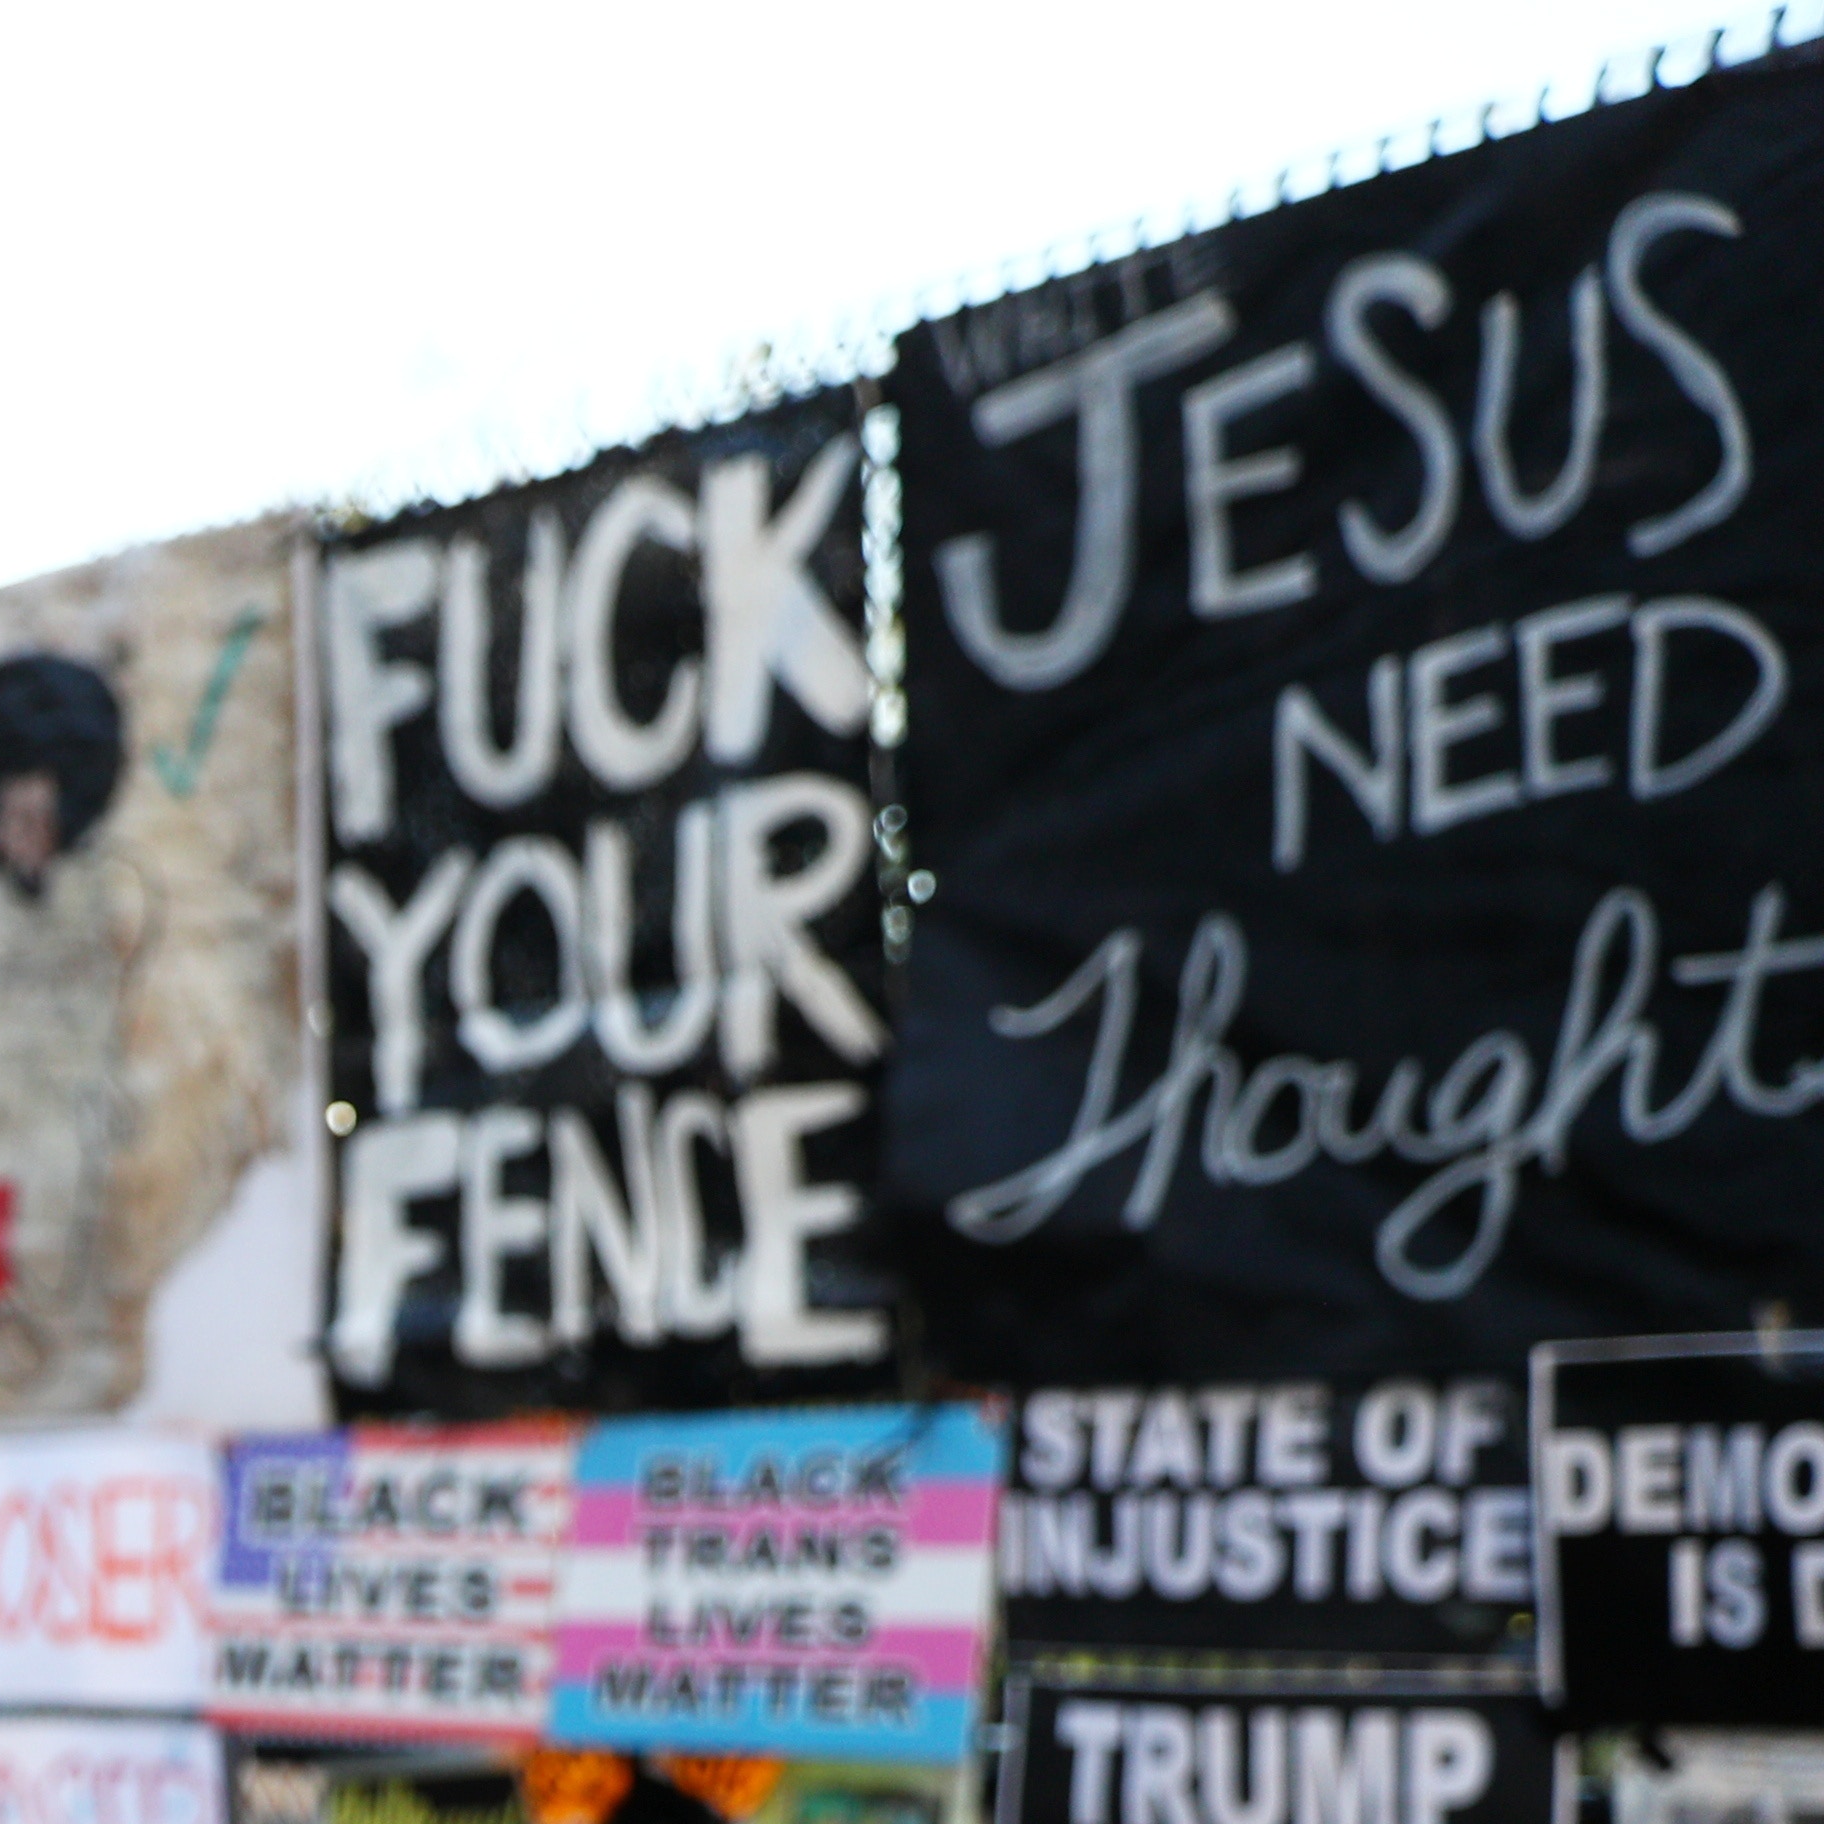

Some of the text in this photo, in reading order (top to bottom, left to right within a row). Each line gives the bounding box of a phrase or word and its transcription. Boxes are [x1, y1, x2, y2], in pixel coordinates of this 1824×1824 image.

[934, 190, 1754, 692] JESUS
[324, 430, 874, 848] FUCK
[1270, 592, 1790, 876] NEED
[330, 770, 892, 1116] YOUR
[326, 1078, 888, 1388] FENCE
[638, 1452, 908, 1516] BLACK
[1020, 1378, 1514, 1492] STATE OF
[250, 1464, 530, 1536] BLACK
[640, 1520, 900, 1578] TRANS
[1000, 1484, 1530, 1602] INJUSTICE
[272, 1558, 502, 1622] LIVES
[642, 1594, 878, 1650] LIVES
[1668, 1534, 1768, 1650] IS
[216, 1638, 530, 1702] MATTER
[594, 1660, 918, 1724] MATTER
